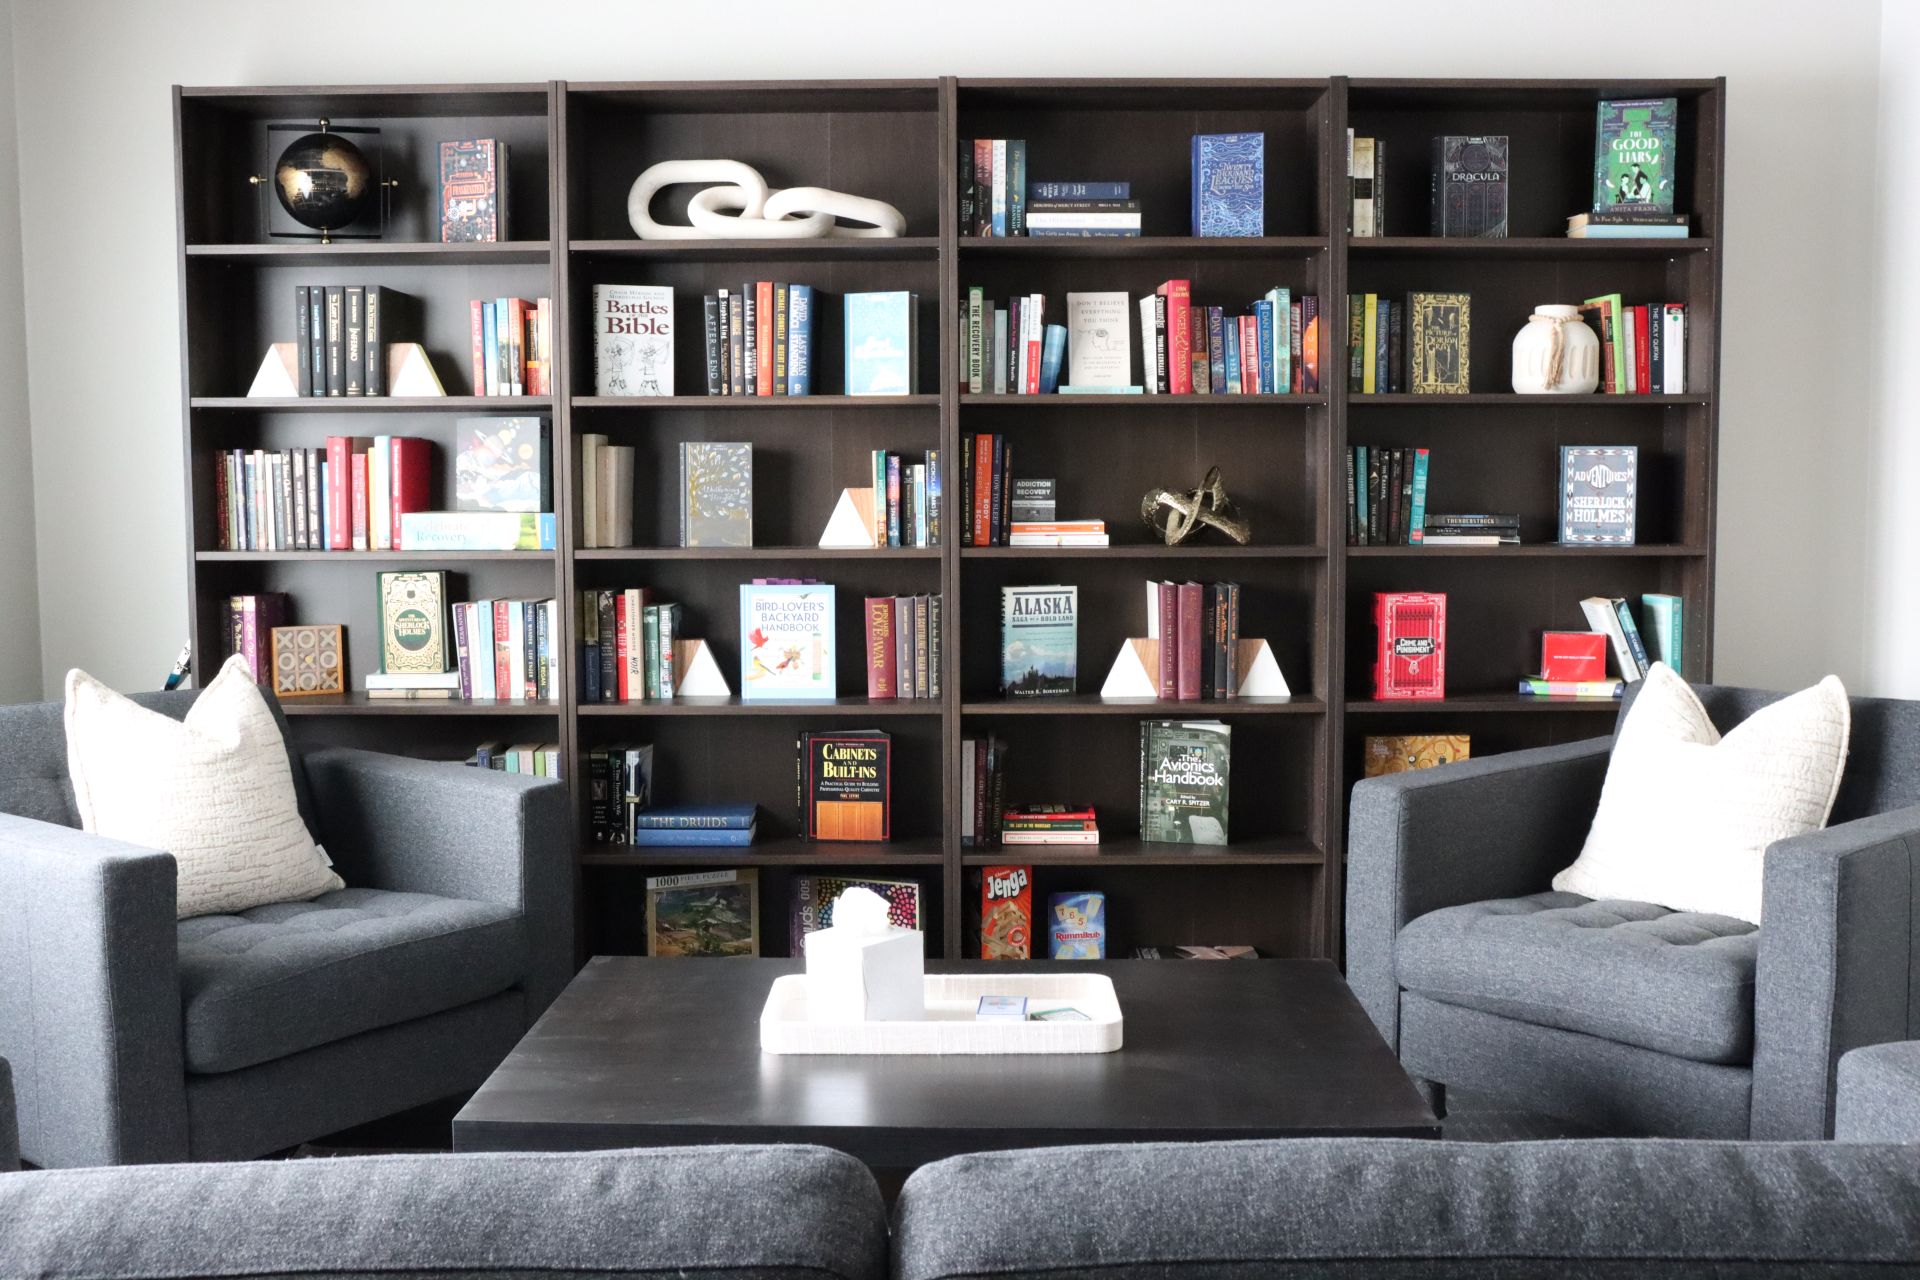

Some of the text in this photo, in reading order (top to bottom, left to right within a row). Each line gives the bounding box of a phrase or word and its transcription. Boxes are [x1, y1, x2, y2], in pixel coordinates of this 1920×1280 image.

[1612, 137, 1659, 151] GOOD
[1619, 151, 1653, 163] LIARS
[1452, 172, 1500, 182] DRACULA
[605, 300, 668, 314] Battles
[746, 300, 754, 322] ALAN
[777, 289, 785, 340] MICHAEL CONNELLY
[799, 297, 808, 322] DAVID
[605, 316, 670, 335] Bible
[708, 314, 717, 344] AFTER
[1178, 305, 1187, 336] ANGELS
[746, 325, 754, 347] JUDD
[1262, 311, 1270, 358] DAN BROWN
[1291, 307, 1301, 356] OUTLAWS
[1352, 315, 1361, 347] MAZE
[349, 328, 361, 361] INFERNO
[972, 305, 981, 378] THE RECOVERY BOOK
[1211, 317, 1221, 367] DAN BROWN
[790, 334, 799, 377] STANDING
[799, 335, 808, 377] LAST MAN
[710, 359, 718, 379] END
[1177, 351, 1187, 382] DEMONS
[1574, 465, 1627, 489] ADVENTURES
[993, 493, 999, 502] TO
[1573, 496, 1625, 508] SHERLOCK
[1573, 509, 1626, 522] HOLMES
[416, 530, 468, 543] Recovery
[755, 602, 825, 611] BIRD-LOVER'S
[1013, 596, 1073, 615] ALASKA
[394, 621, 431, 630] SHERLOCK
[761, 613, 820, 622] BACKYARD
[918, 604, 926, 650] LISA SCOTTOLINE
[398, 629, 426, 637] HOLMES
[872, 604, 885, 668] LOVE WAR
[1396, 645, 1430, 653] PUNISHMENT
[630, 656, 640, 674] NOIR
[823, 743, 877, 760] CABINETS
[1180, 754, 1199, 762] The
[823, 762, 878, 778] BUILT-INS
[1160, 757, 1215, 773] Avionics
[1154, 769, 1223, 786] Handbook
[650, 817, 727, 828] THE DRUIDS
[655, 876, 680, 888] 1000
[702, 871, 729, 879] PUZZLE
[987, 868, 1028, 899] Jenga
[800, 879, 811, 900] 500
[1056, 931, 1100, 942] Rummikub
